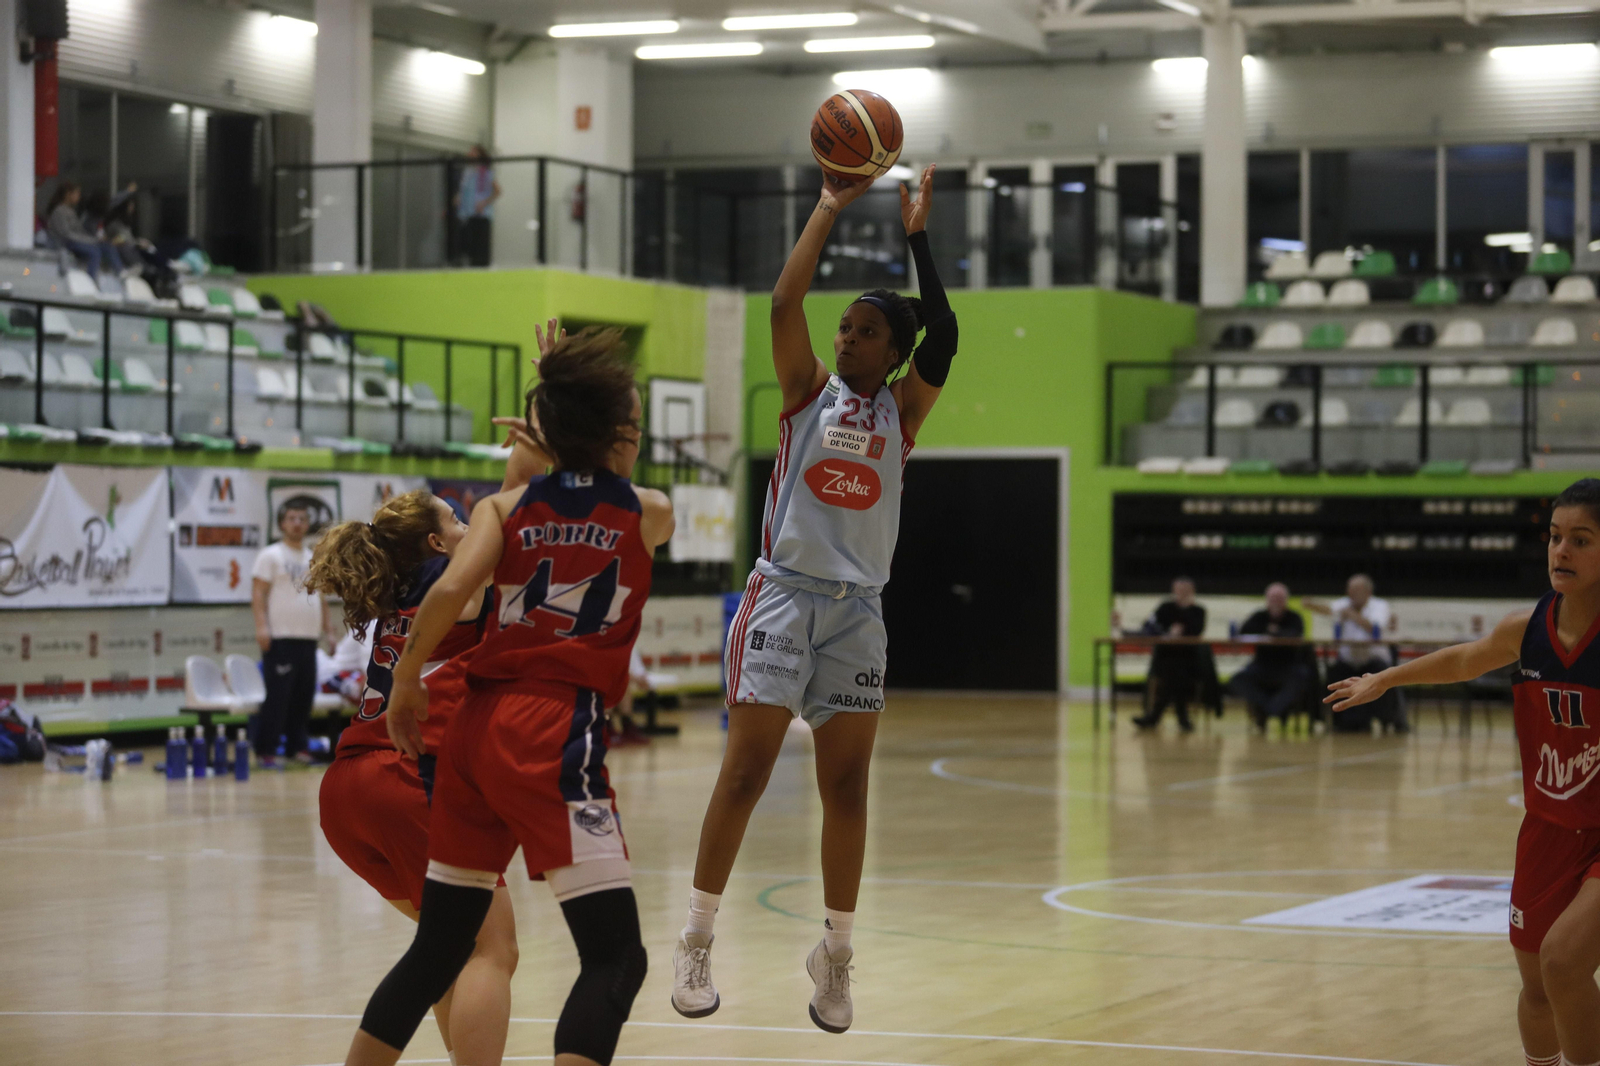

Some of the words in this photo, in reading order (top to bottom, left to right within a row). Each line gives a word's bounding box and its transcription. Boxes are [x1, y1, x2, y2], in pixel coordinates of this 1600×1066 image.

[825, 99, 858, 139] molten
[838, 398, 876, 432] 23
[828, 430, 866, 443] CONCELLO
[841, 441, 860, 451] VIGO
[822, 466, 870, 497] Zorka
[766, 641, 776, 650] DE
[777, 644, 804, 656] GALICIA
[768, 634, 793, 646] XUNTA
[1543, 688, 1590, 728] 11
